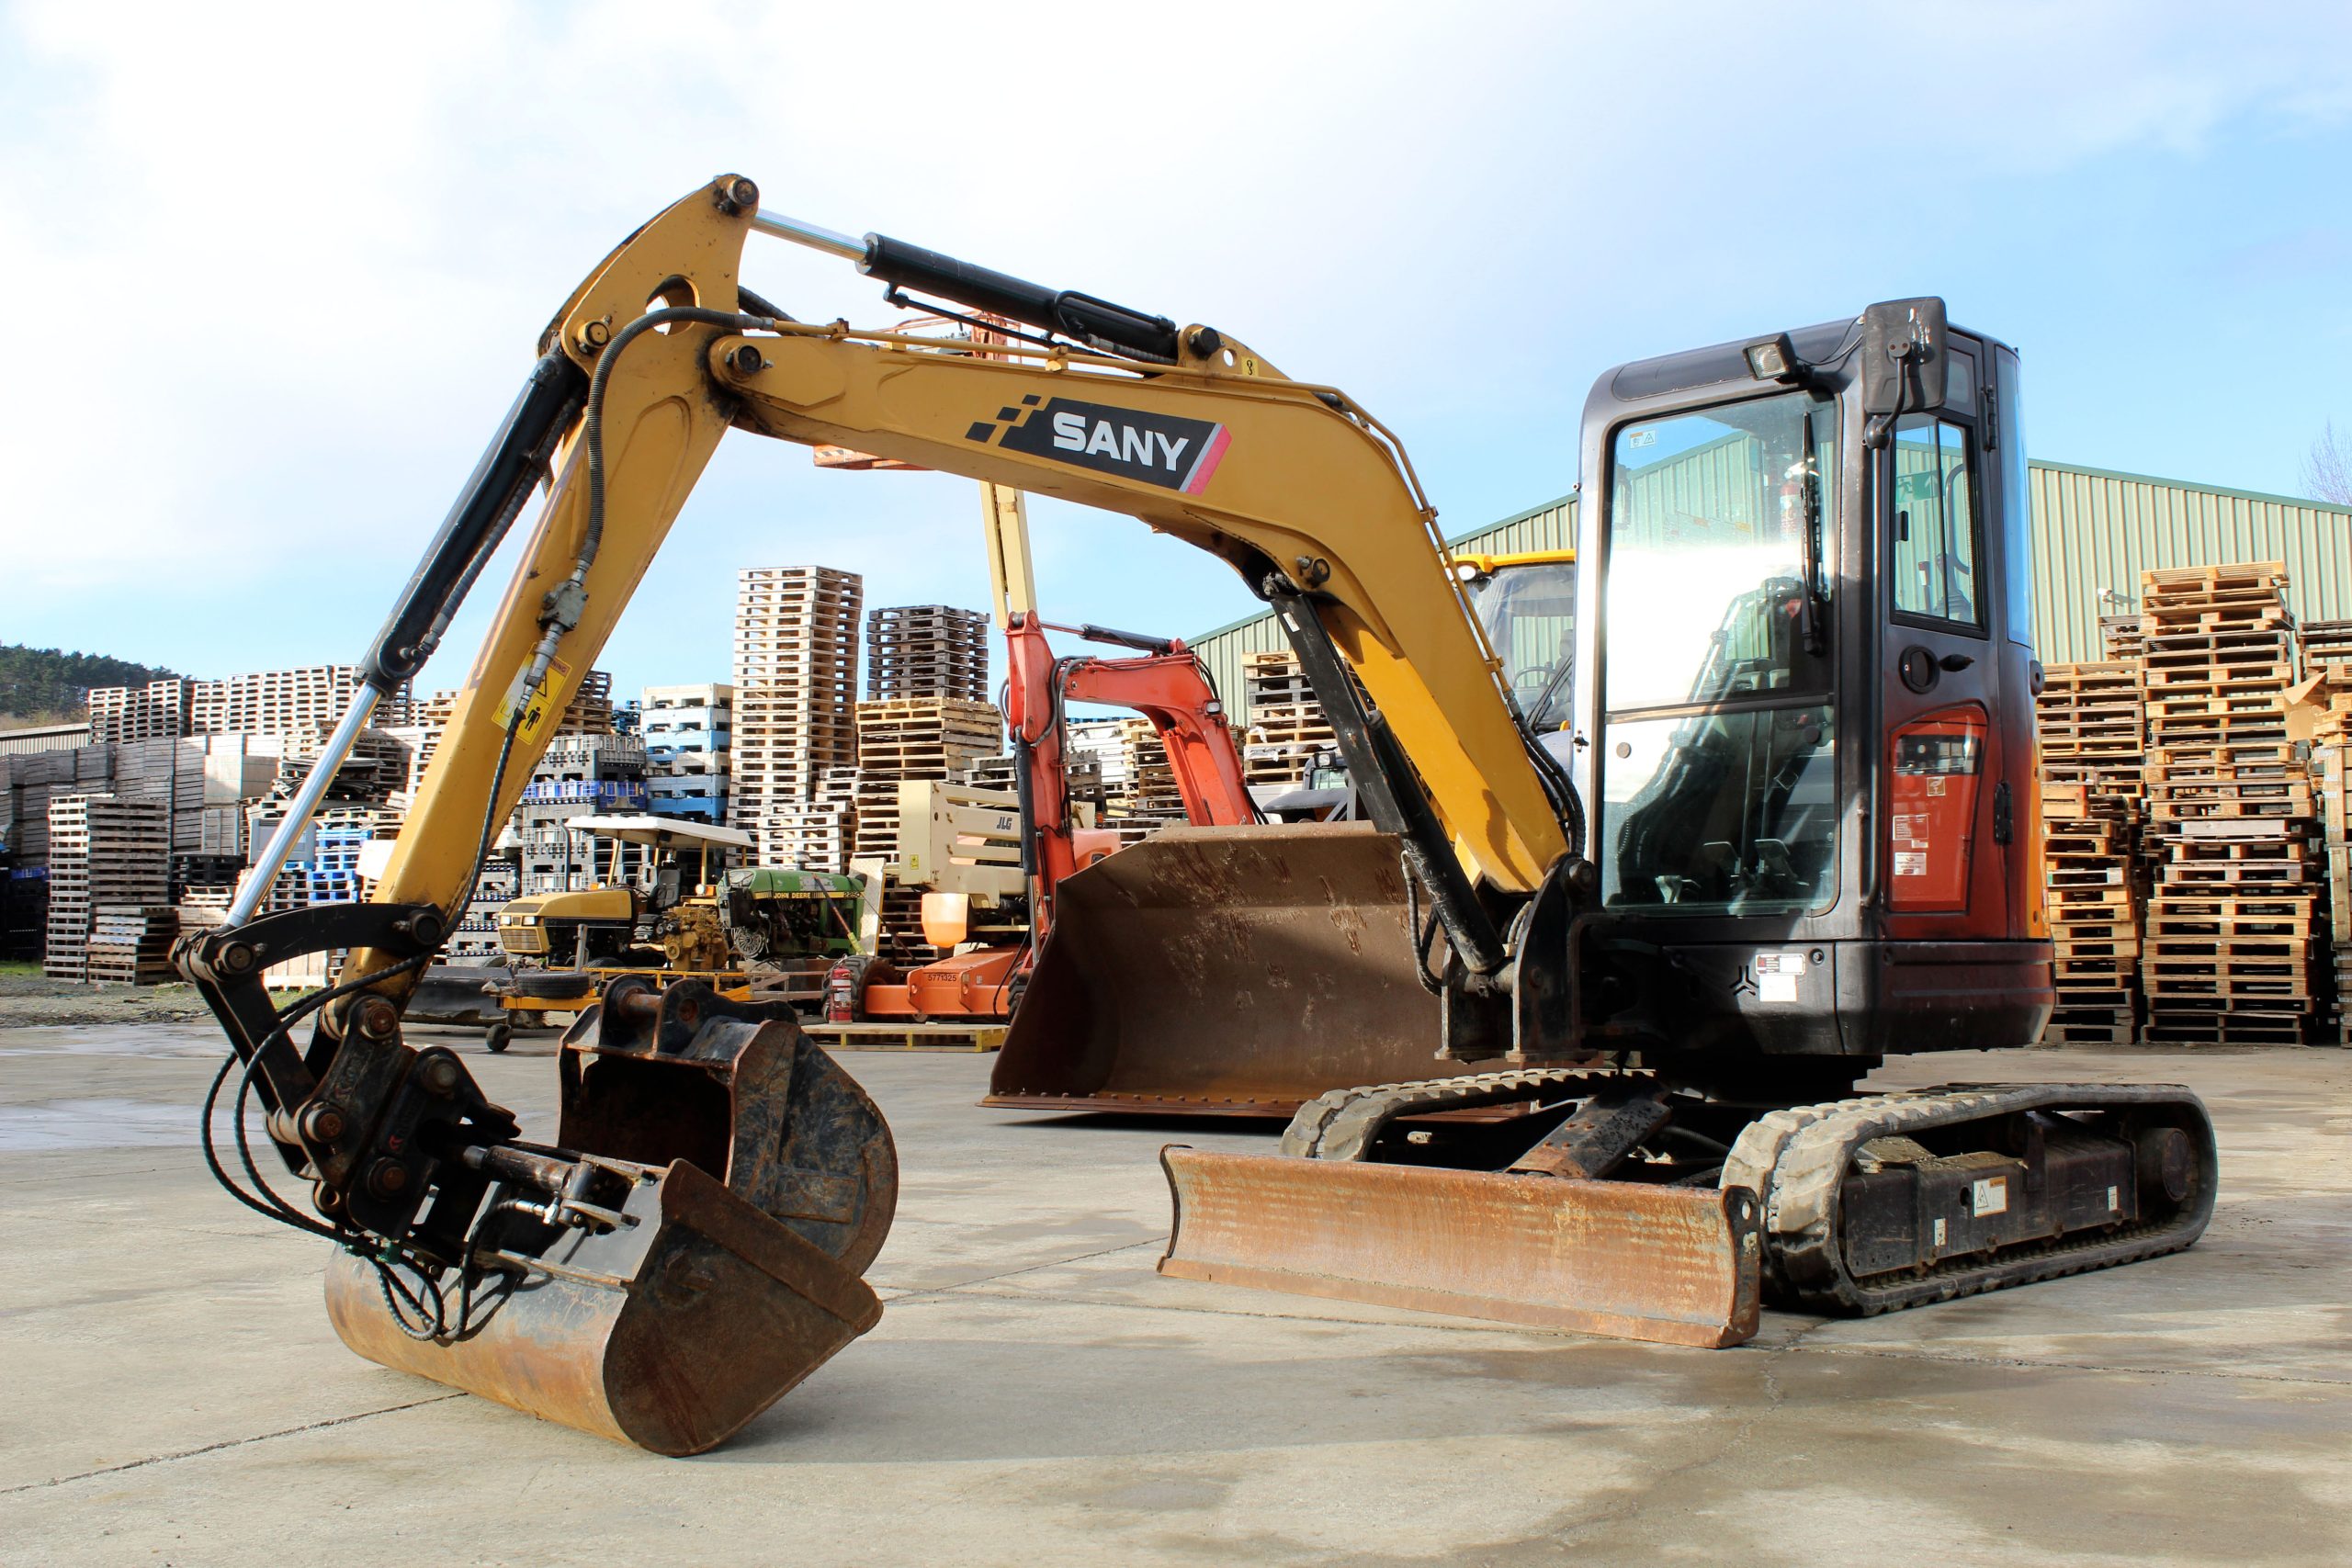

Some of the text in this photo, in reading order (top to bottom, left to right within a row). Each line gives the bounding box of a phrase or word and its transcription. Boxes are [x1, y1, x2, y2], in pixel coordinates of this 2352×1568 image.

[1053, 412, 1189, 471] SANY
[996, 816, 1012, 830] JLG
[928, 974, 957, 982] 5771325
